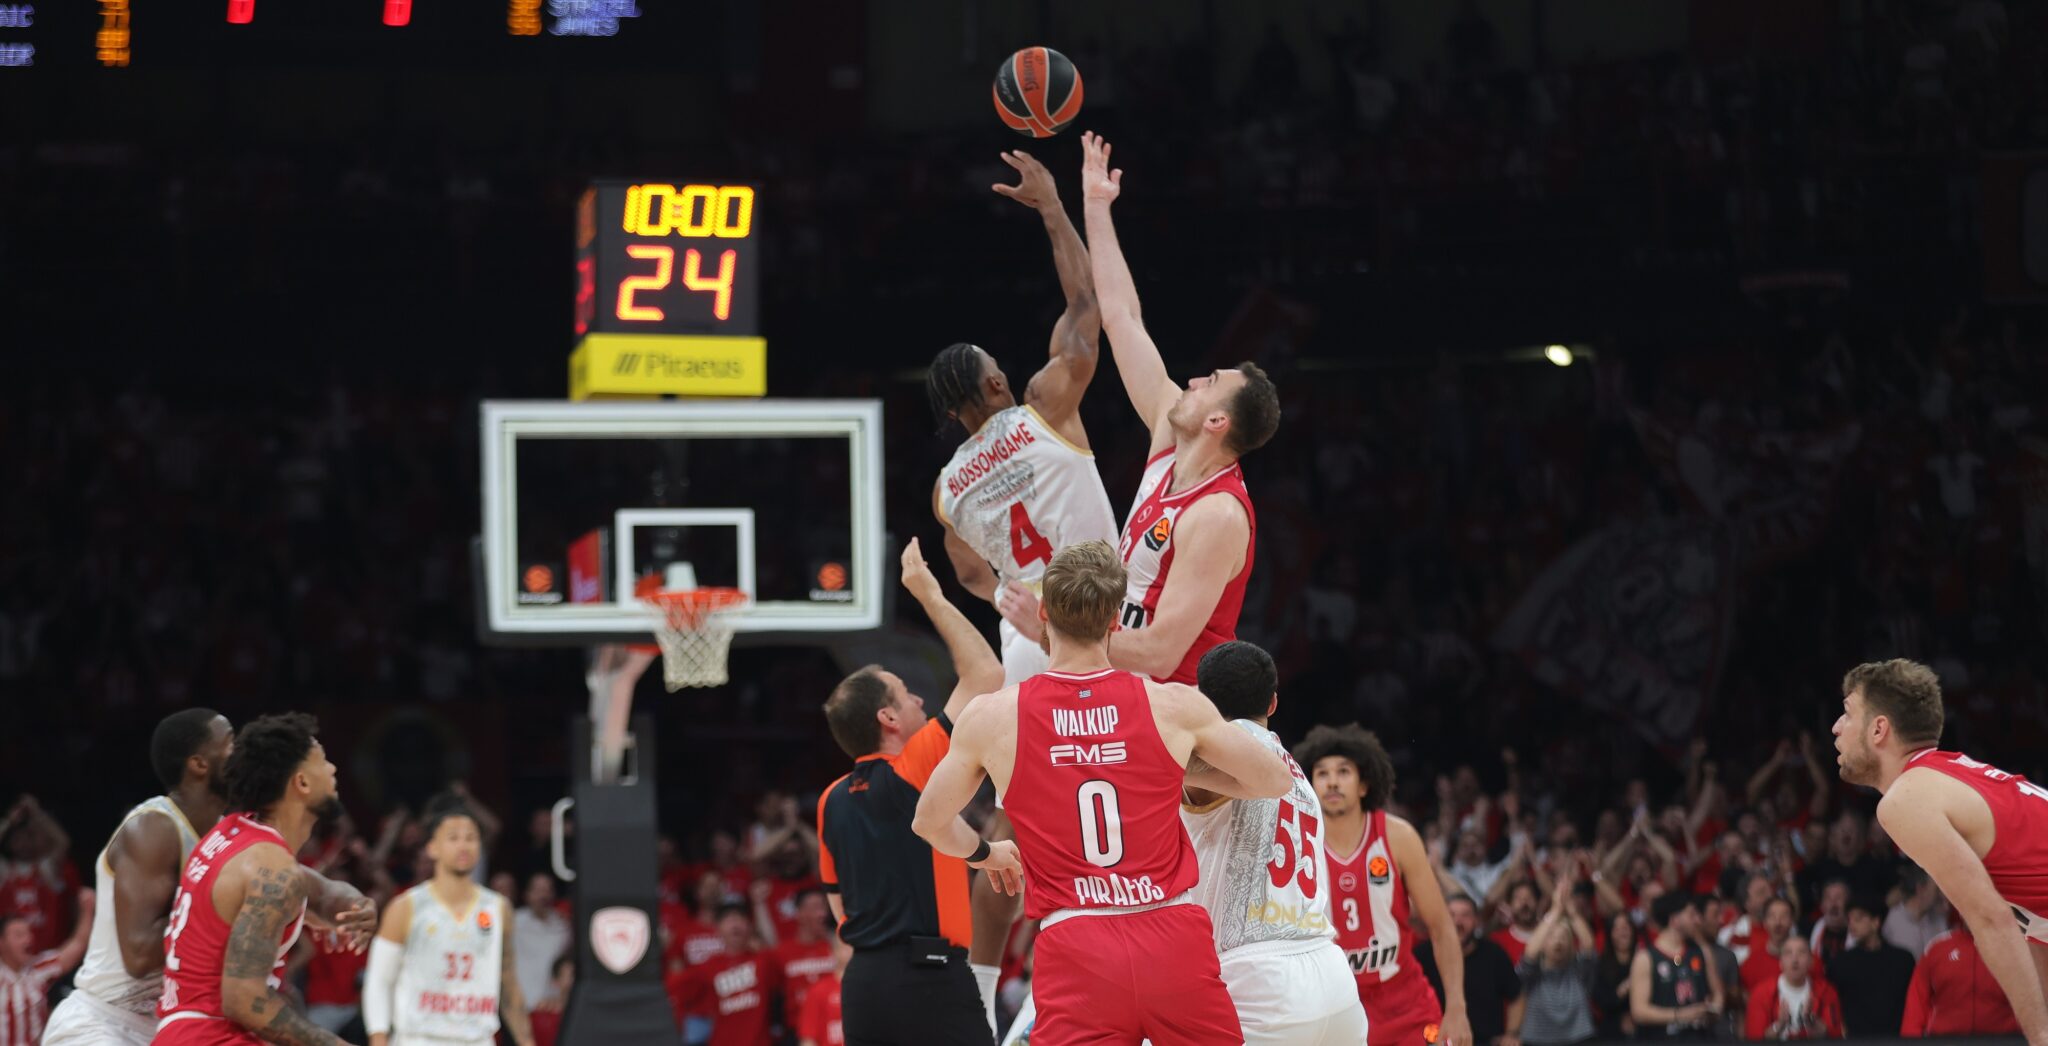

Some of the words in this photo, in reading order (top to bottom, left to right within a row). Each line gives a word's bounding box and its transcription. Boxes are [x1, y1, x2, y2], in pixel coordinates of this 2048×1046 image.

[623, 184, 754, 239] 10:00
[616, 245, 737, 321] 24
[645, 352, 744, 379] Piraeus
[947, 422, 1036, 498] BLOSSOMGAME
[1010, 500, 1054, 569] 4
[1052, 704, 1119, 737] WALKUP
[1050, 741, 1127, 766] FMS
[1077, 778, 1124, 869] 0
[1267, 798, 1318, 899] 55
[1342, 897, 1360, 931] 3
[443, 952, 474, 980] 32
